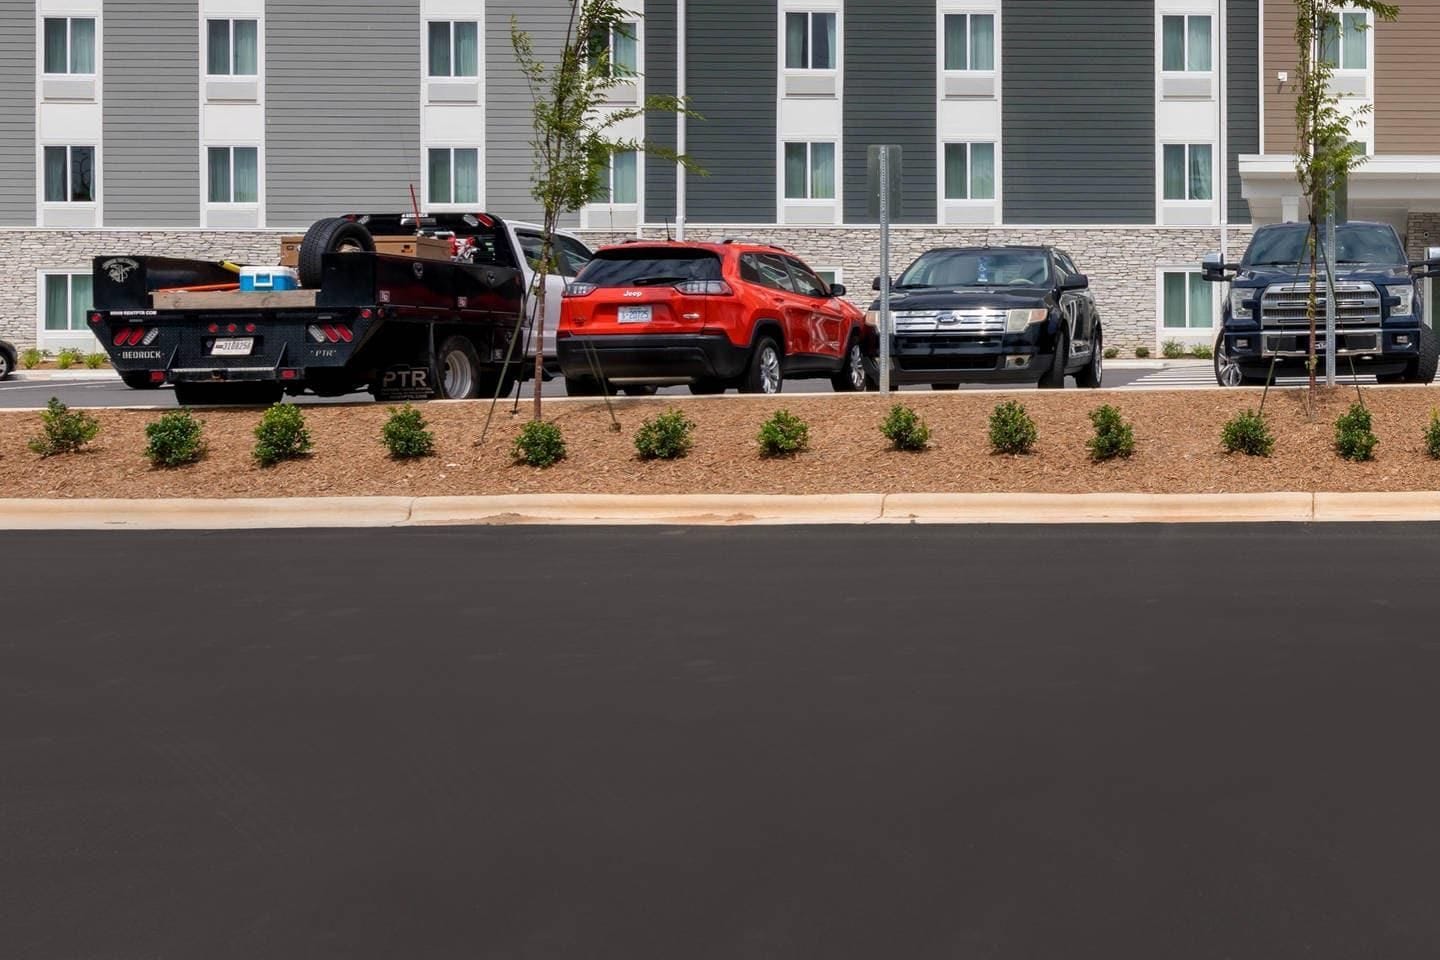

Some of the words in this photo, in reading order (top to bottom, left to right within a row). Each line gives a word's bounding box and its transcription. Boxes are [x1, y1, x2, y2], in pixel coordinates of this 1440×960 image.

[623, 289, 643, 297] Jeep
[122, 350, 161, 359] BEDROCK
[383, 370, 427, 387] PTR
